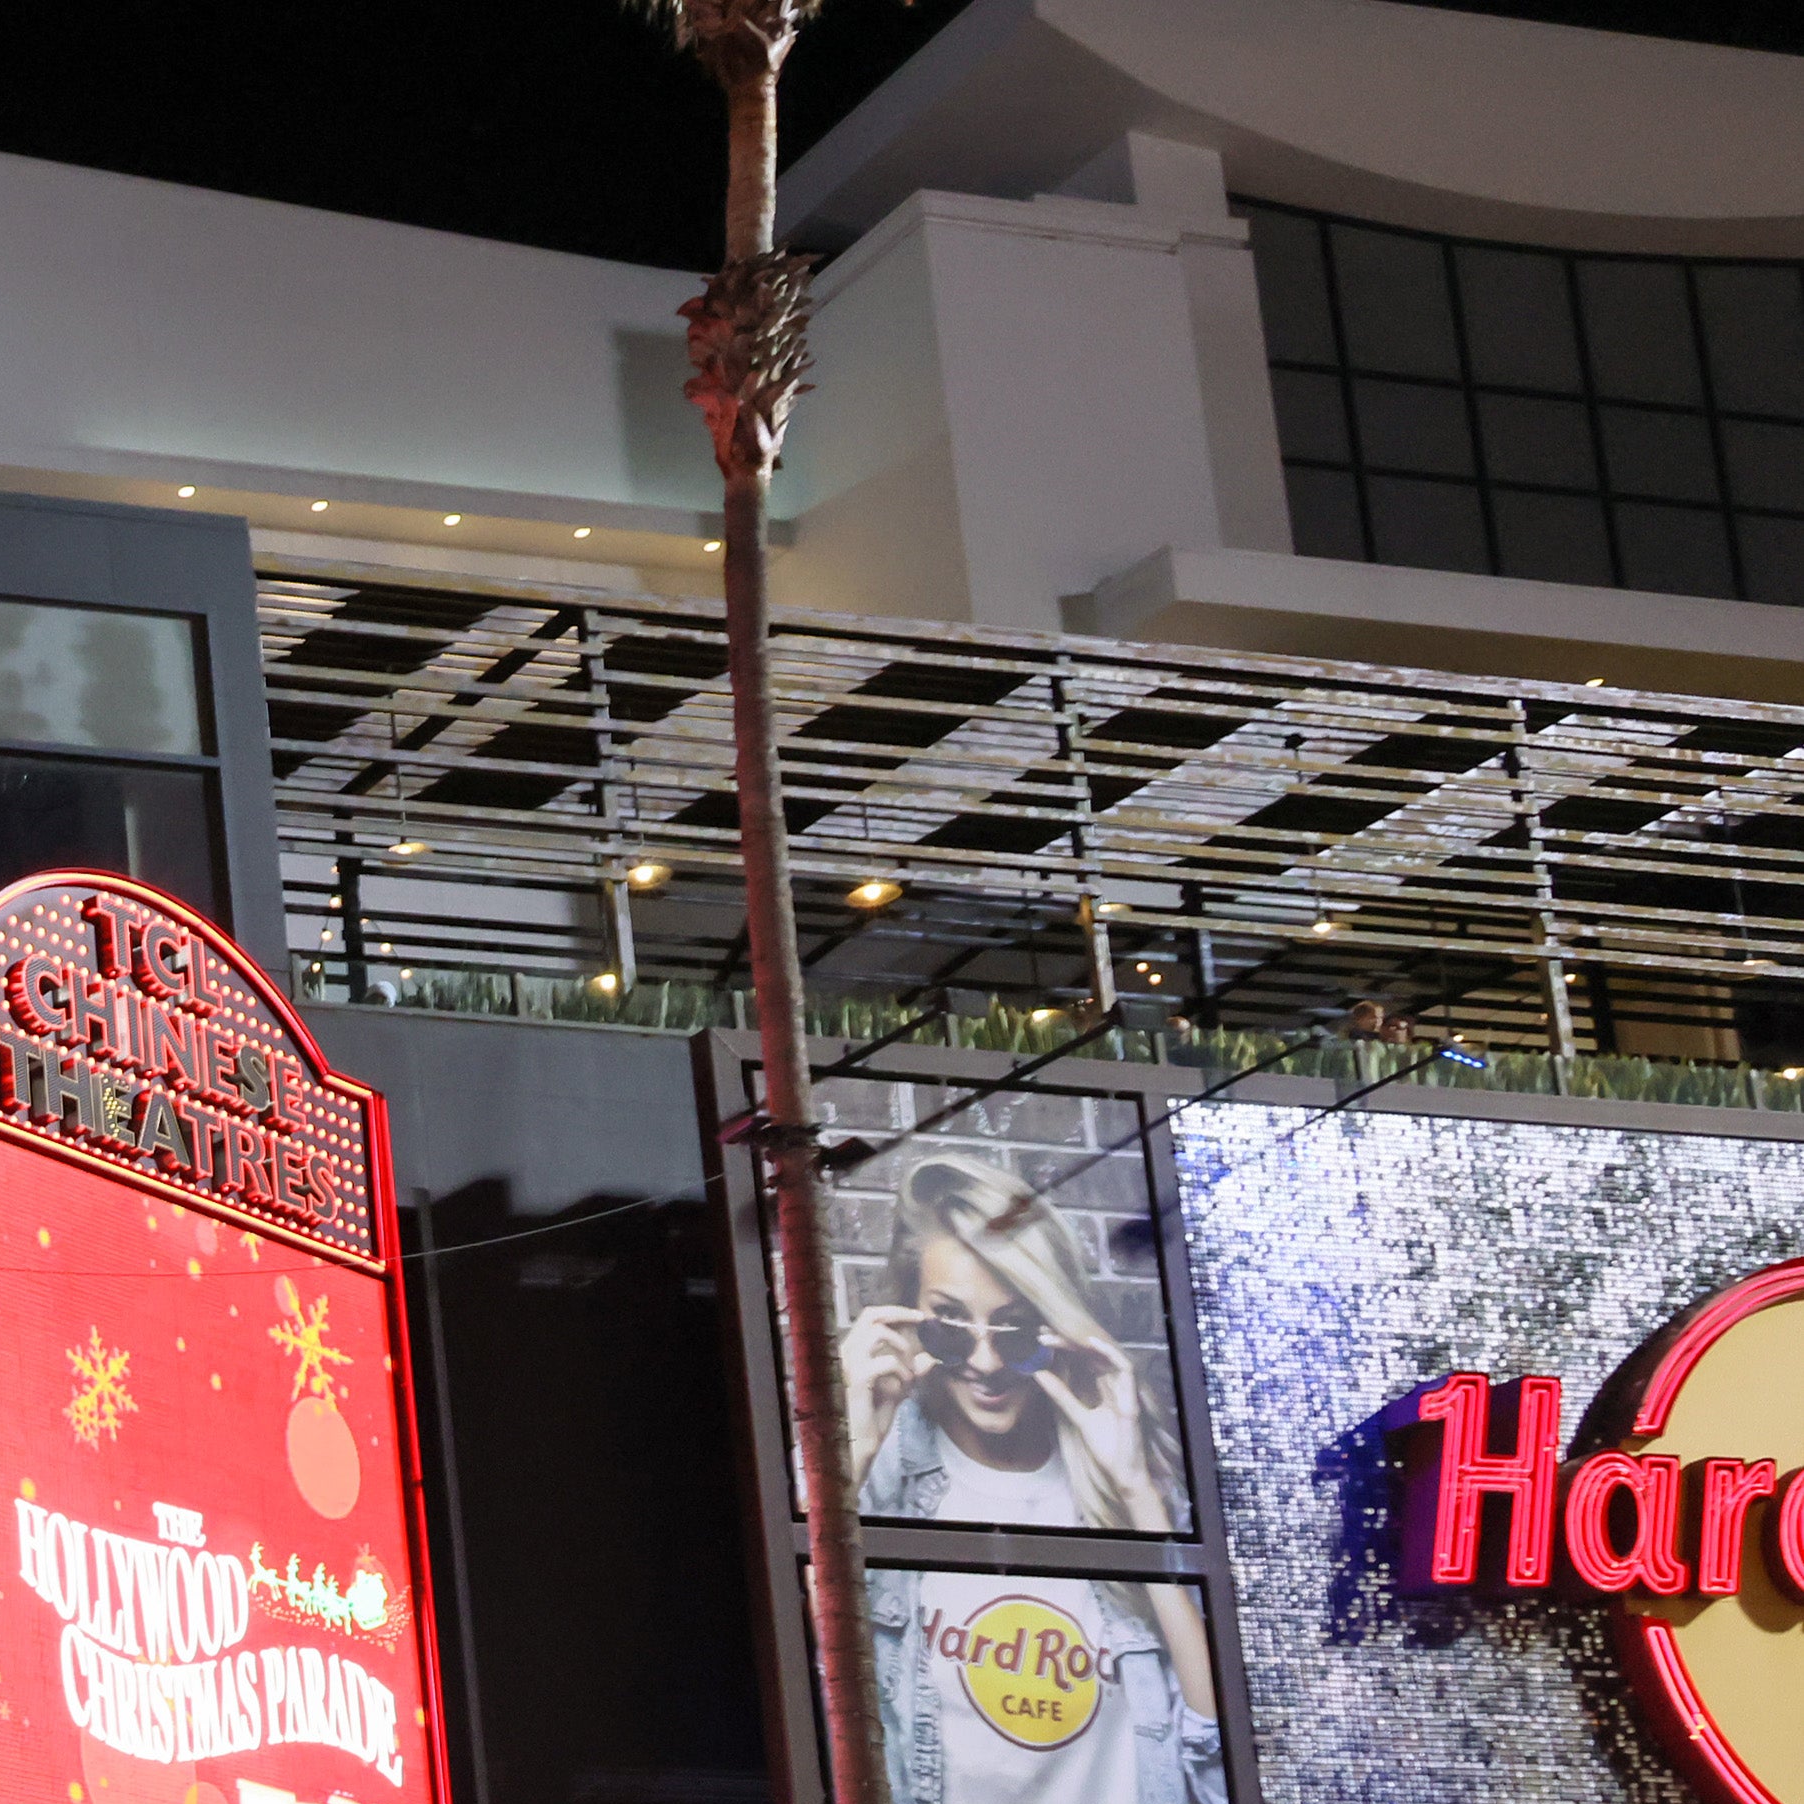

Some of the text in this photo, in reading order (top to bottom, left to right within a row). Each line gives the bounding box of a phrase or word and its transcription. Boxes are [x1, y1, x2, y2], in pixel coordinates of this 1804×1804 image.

[87, 894, 223, 1015] TCL
[5, 952, 307, 1131] CHINESE
[152, 1501, 207, 1548] THE
[1418, 1371, 1804, 1597] Har
[14, 1497, 250, 1663] HOLLYWOOD
[59, 1623, 404, 1788] CHRISTMAS PARADE
[1001, 1694, 1063, 1722] CAFE
[1034, 1628, 1121, 1693] Roc
